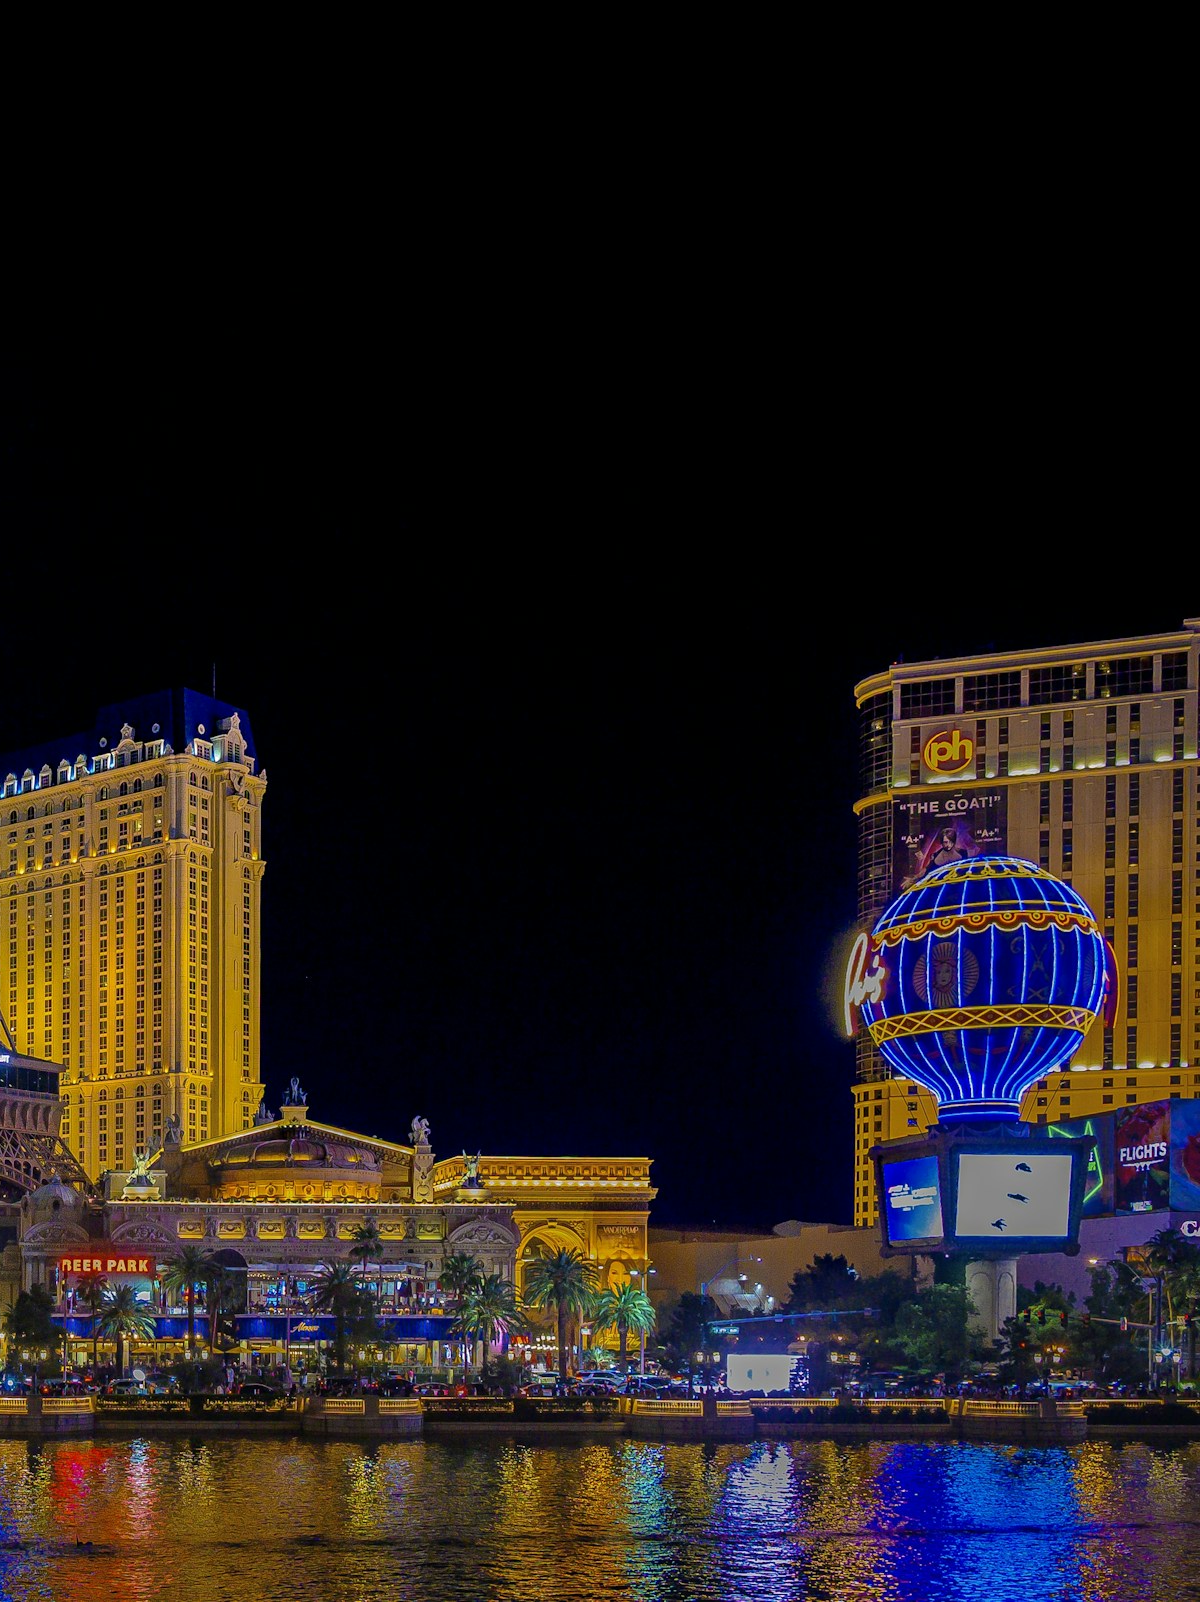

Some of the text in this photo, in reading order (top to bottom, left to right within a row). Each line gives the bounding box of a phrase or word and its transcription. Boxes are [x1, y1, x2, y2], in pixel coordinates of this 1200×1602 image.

[1120, 1142, 1167, 1162] FLIGHTS
[62, 1259, 149, 1272] BEER PARK
